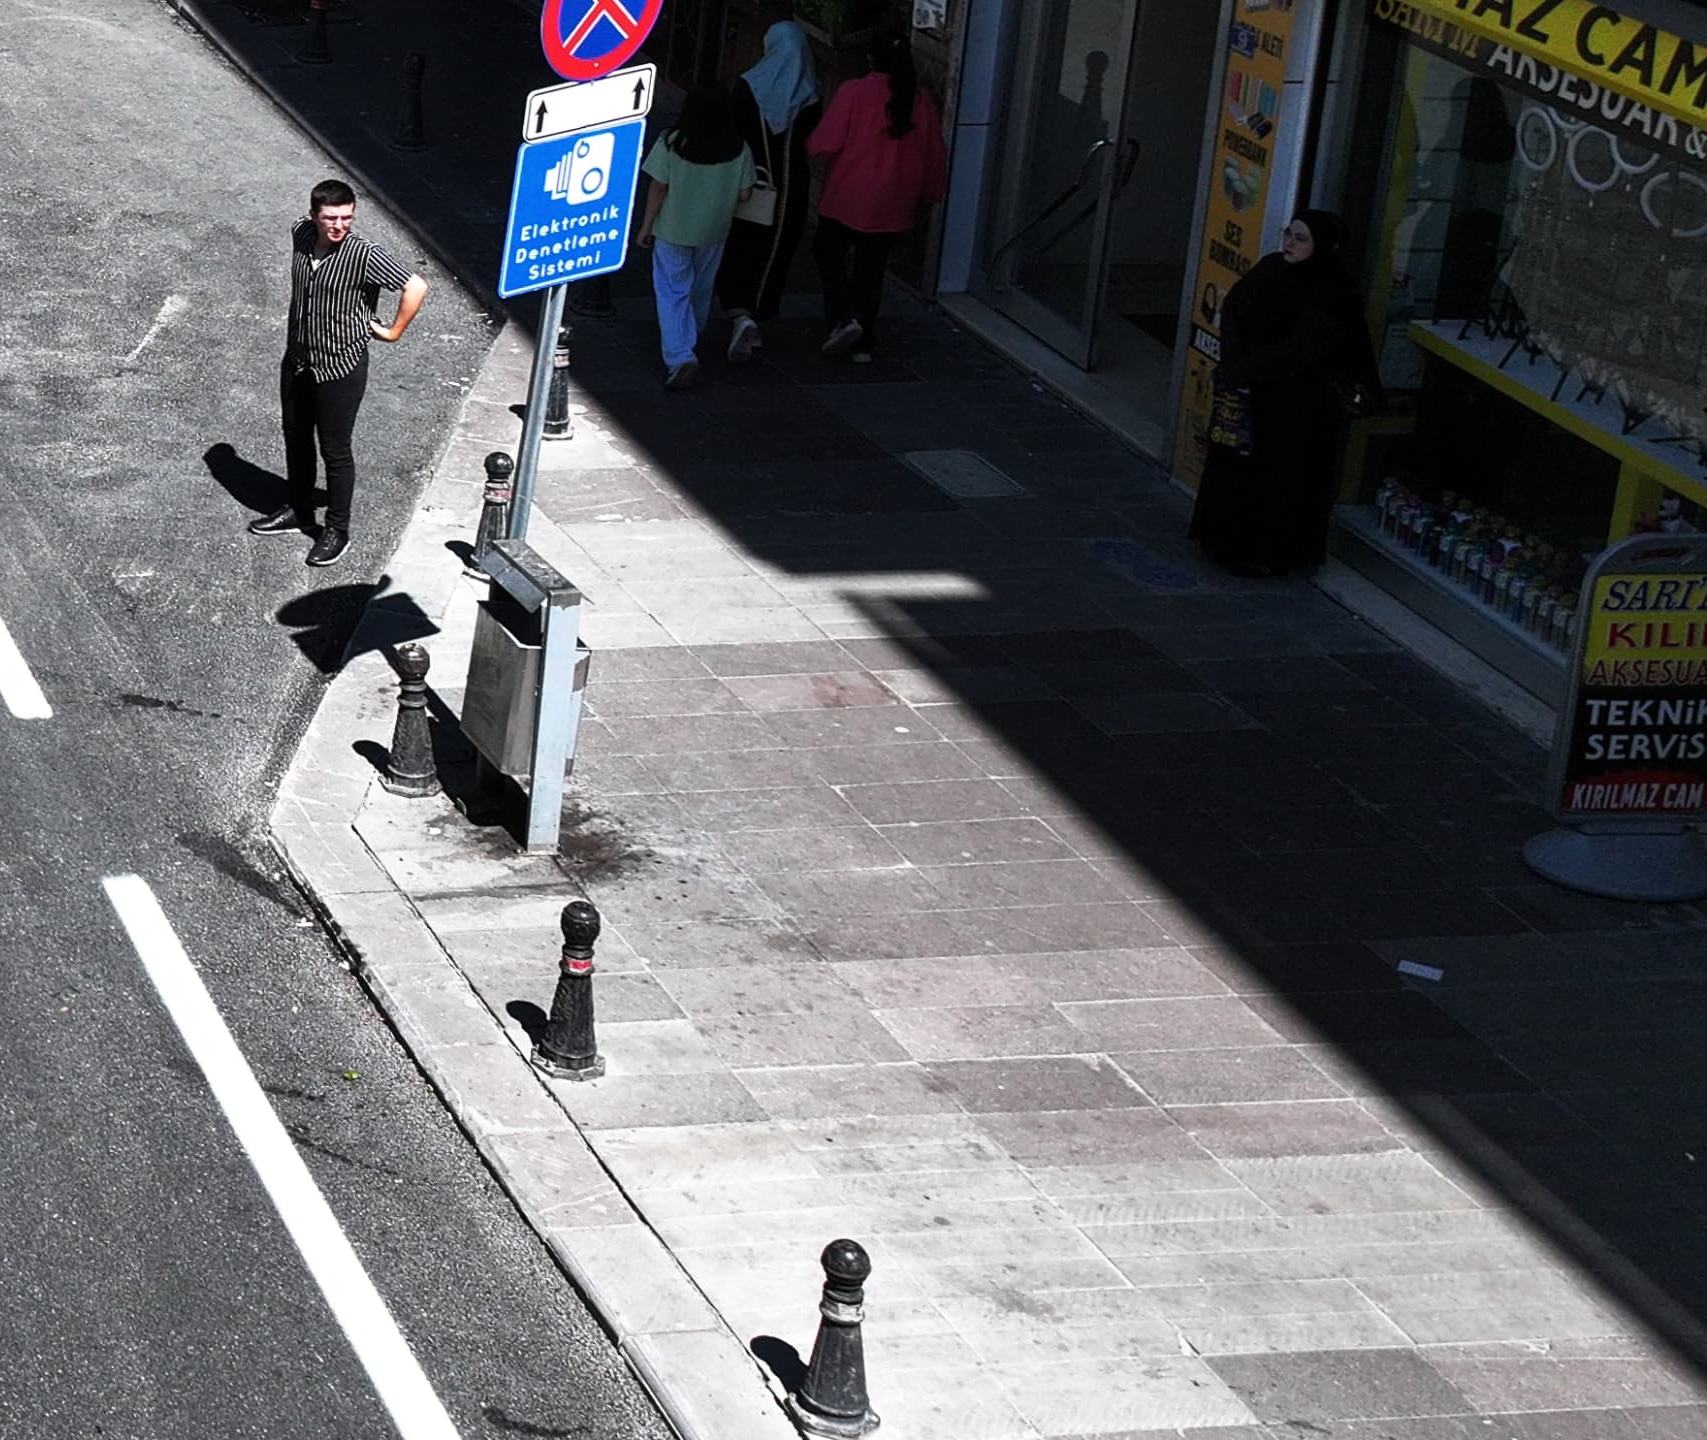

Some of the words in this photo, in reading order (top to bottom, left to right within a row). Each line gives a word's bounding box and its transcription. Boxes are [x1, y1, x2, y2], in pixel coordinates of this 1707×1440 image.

[1576, 7, 1707, 109] CAM
[520, 204, 620, 242] Elektronik
[515, 228, 619, 264] Denetleme
[528, 250, 601, 280] Sistemi
[1603, 579, 1707, 611] SARI'
[1608, 622, 1707, 649] KILI
[1590, 660, 1707, 687] AKSESUA
[1571, 783, 1661, 809] KIRILMAZ
[1664, 783, 1704, 809] CAM
